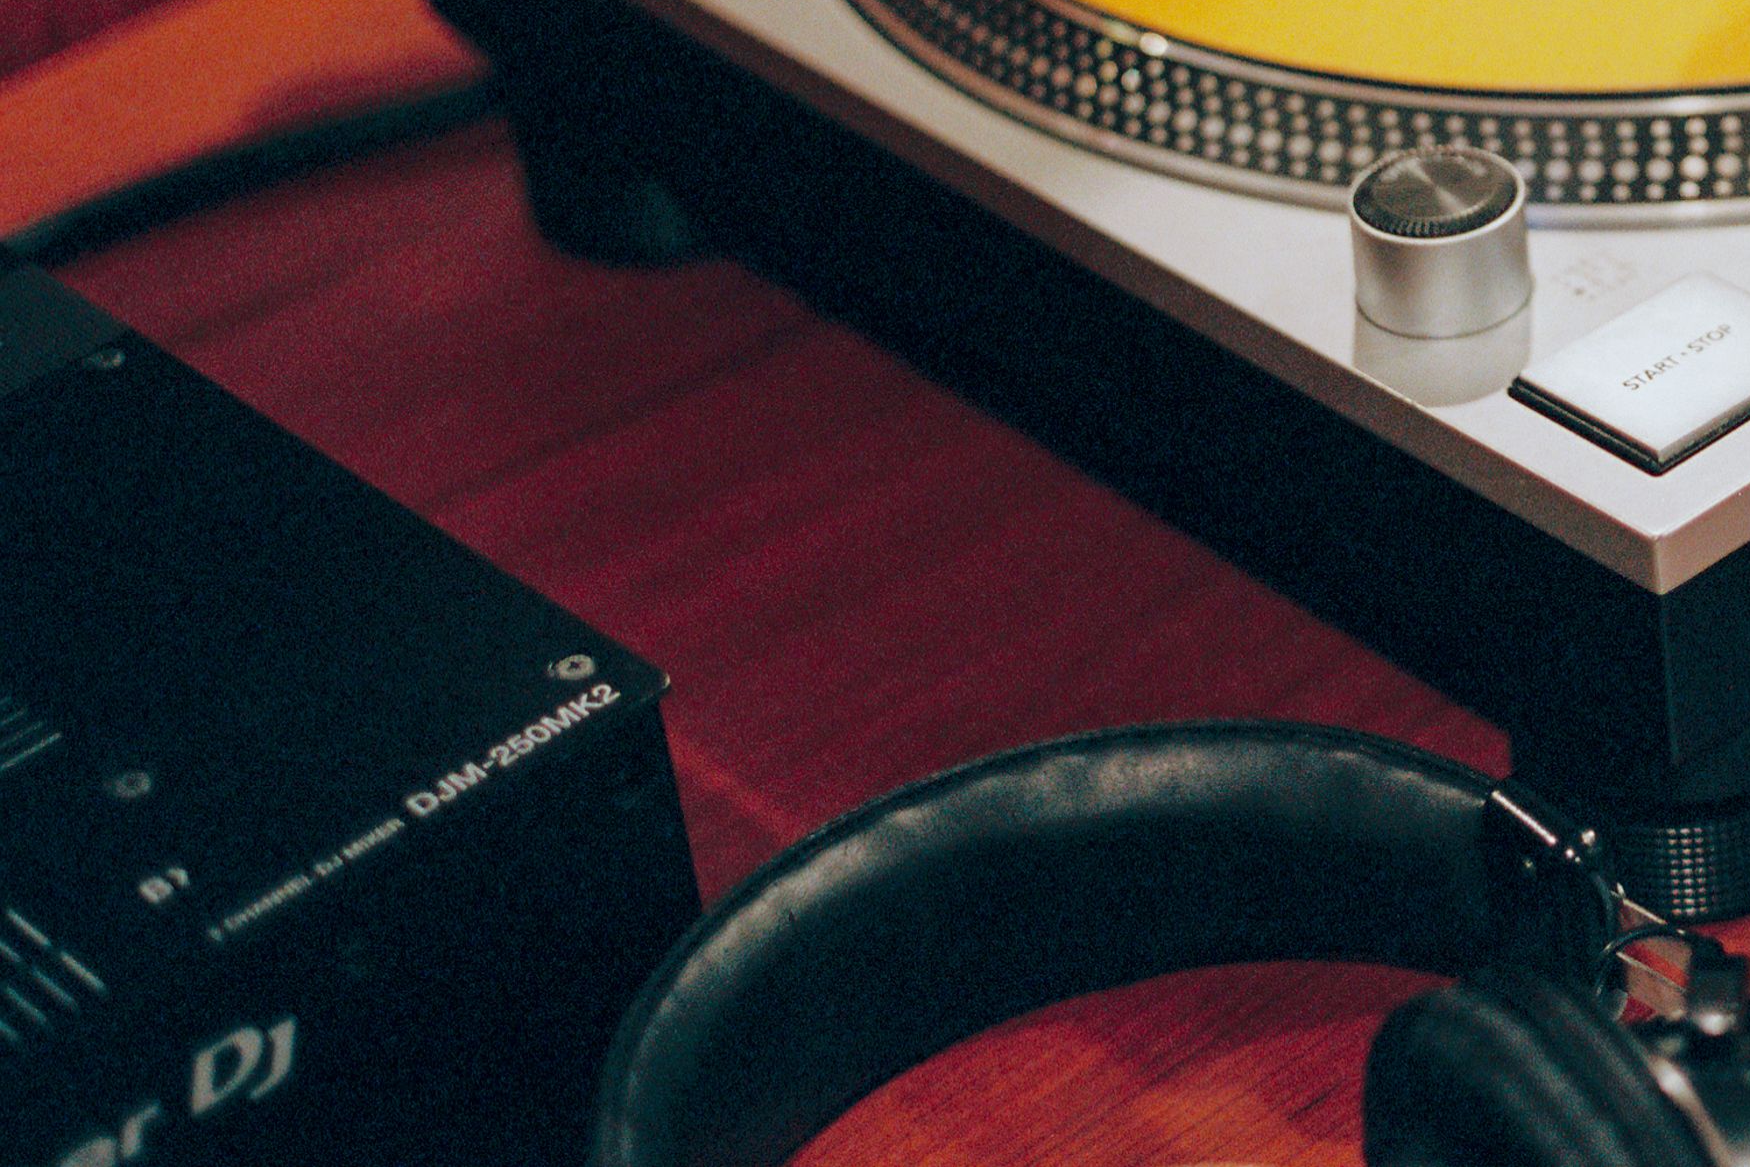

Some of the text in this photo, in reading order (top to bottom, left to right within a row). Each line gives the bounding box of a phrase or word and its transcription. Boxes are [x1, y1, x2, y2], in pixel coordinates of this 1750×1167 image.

[1622, 324, 1732, 391] START STOP
[405, 683, 621, 817] DJM-250MK2
[191, 1019, 297, 1116] DJ
